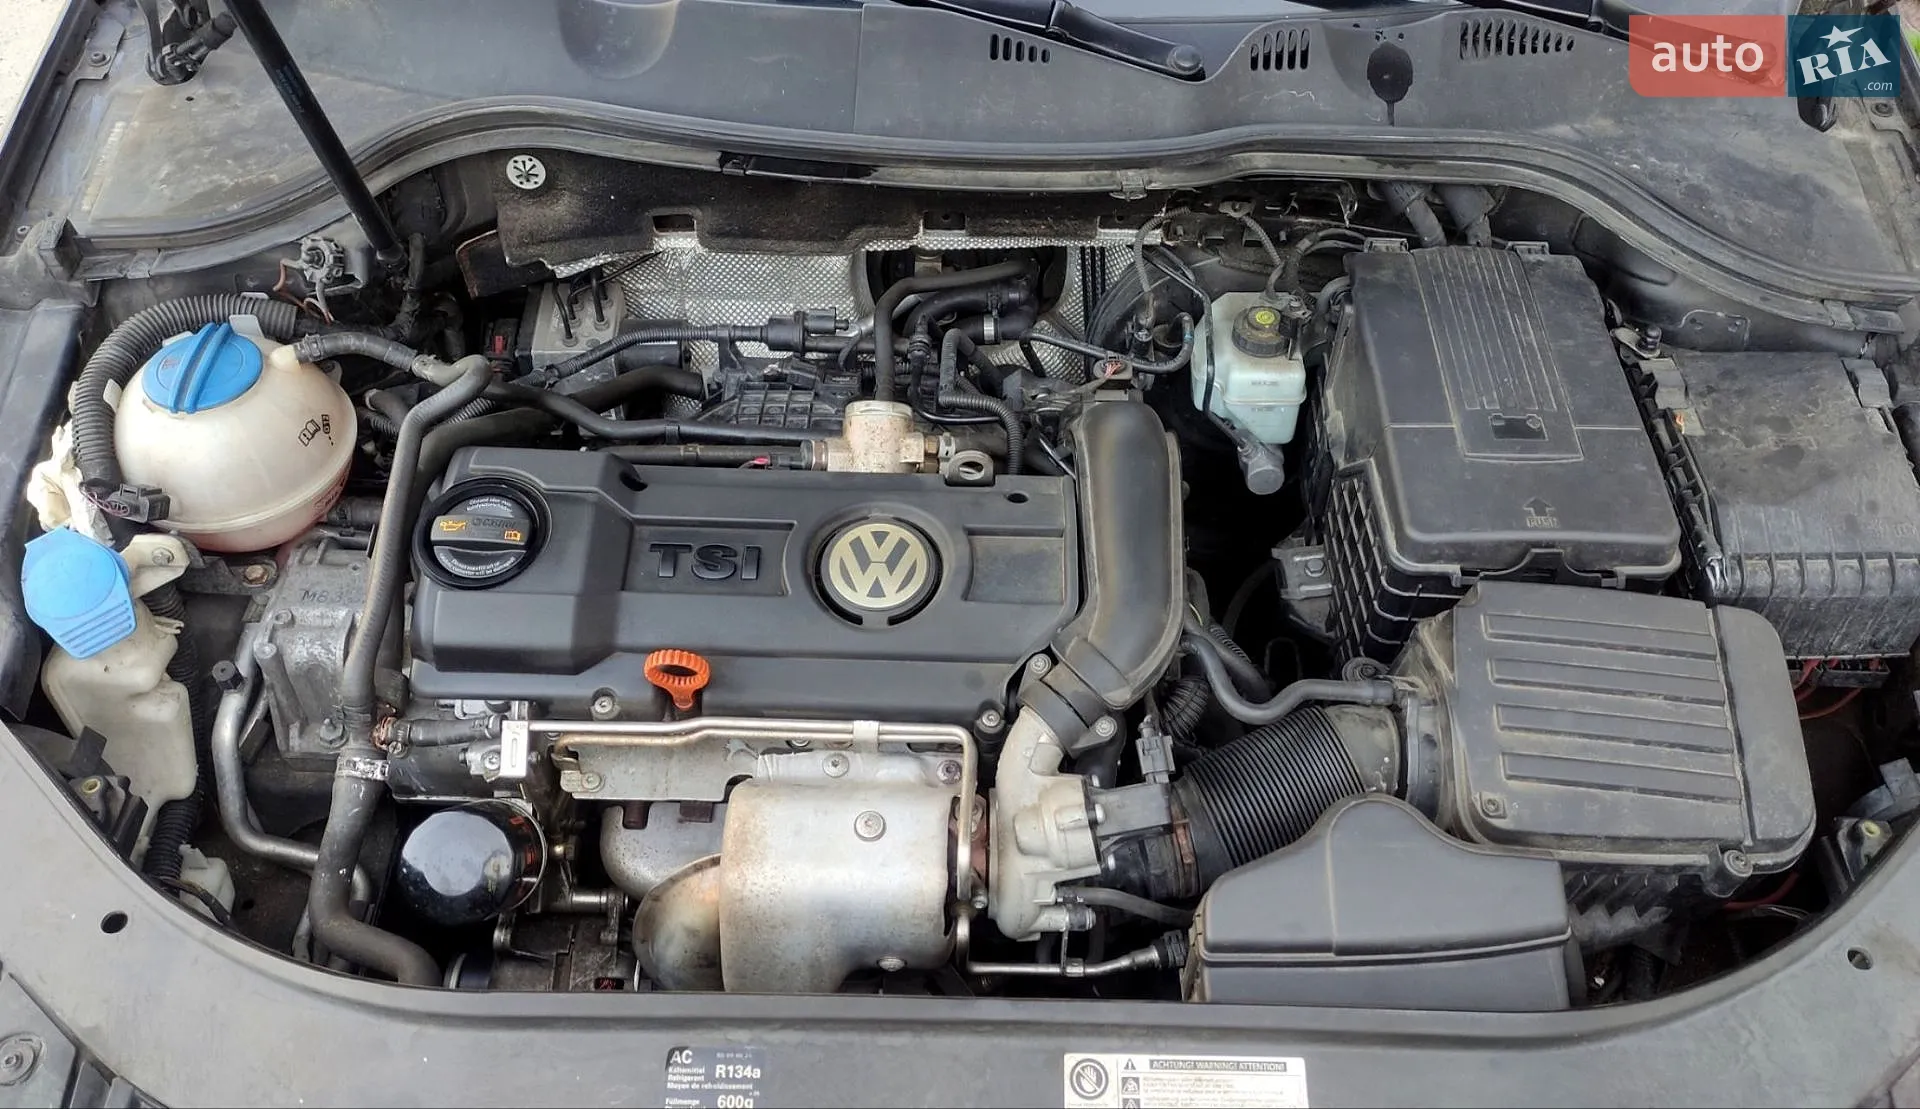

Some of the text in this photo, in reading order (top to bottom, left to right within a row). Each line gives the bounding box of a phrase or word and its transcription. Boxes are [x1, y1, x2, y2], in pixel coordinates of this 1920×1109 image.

[649, 543, 762, 581] TSI
[829, 523, 928, 609] VW
[670, 1049, 693, 1065] AC
[715, 1064, 761, 1079] R134a
